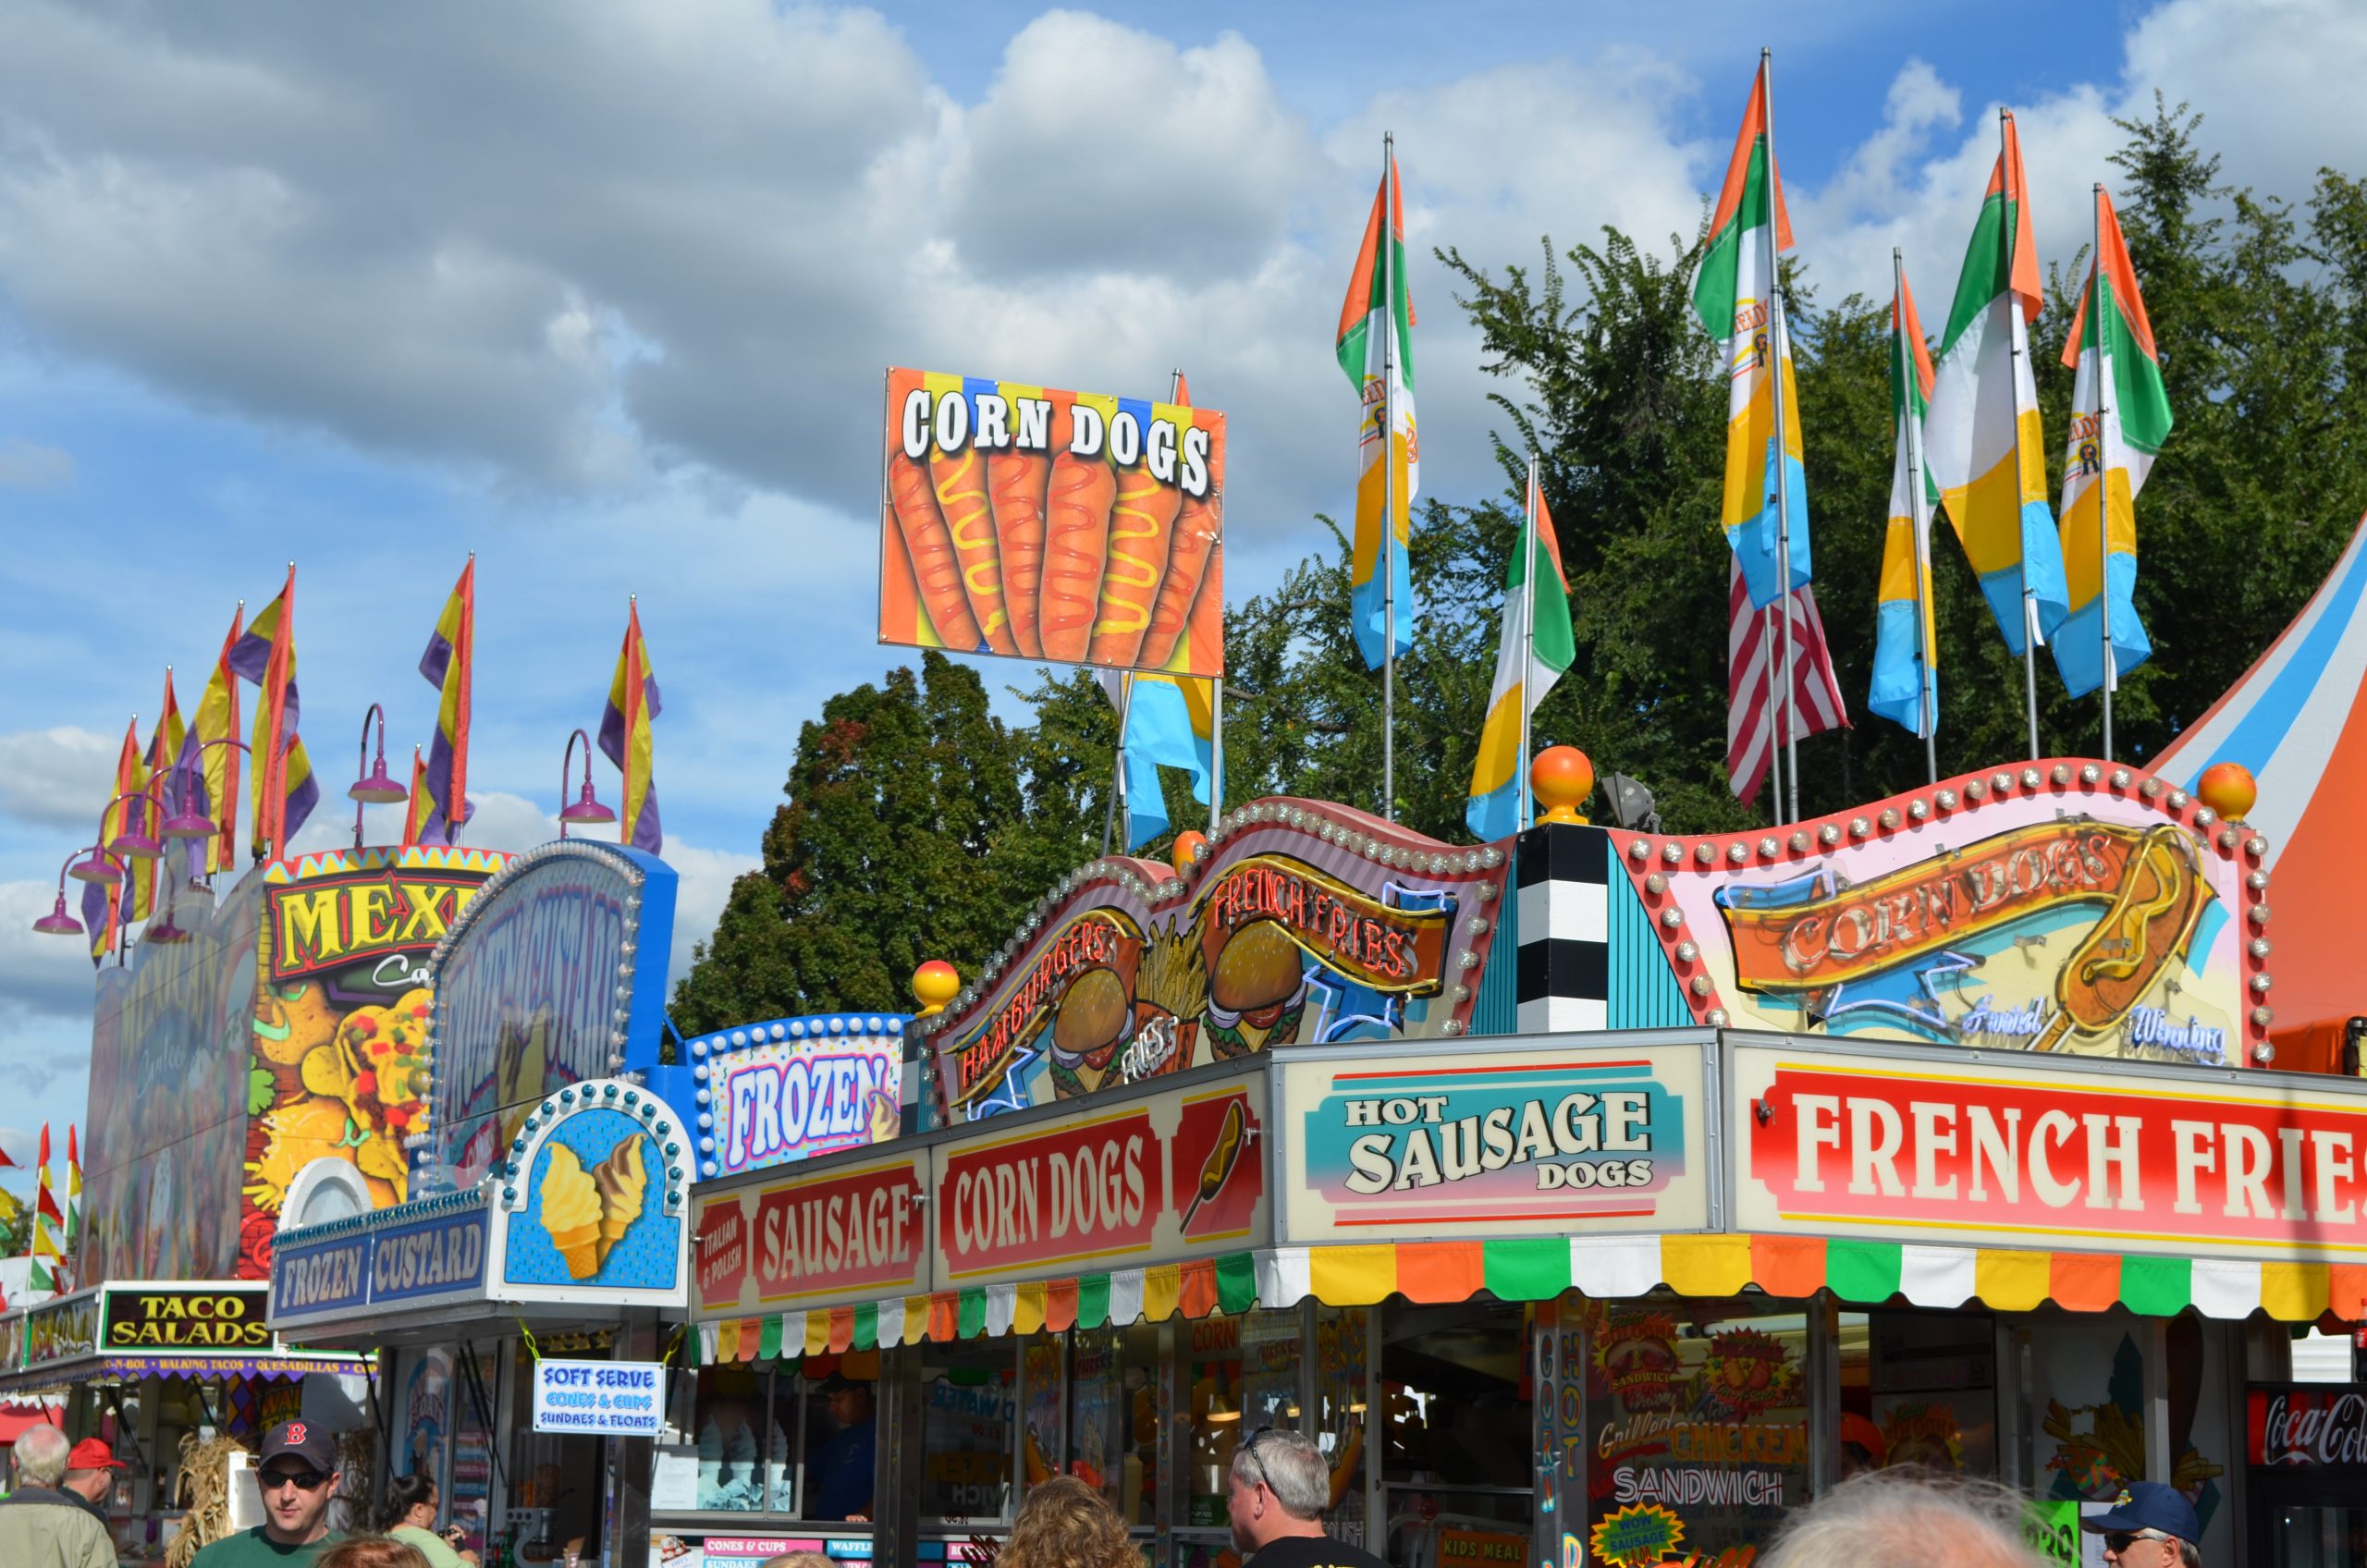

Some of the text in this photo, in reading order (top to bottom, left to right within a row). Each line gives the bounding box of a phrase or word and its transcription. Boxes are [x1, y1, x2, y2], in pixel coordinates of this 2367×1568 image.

[901, 388, 1208, 496] CORN DOGS
[1214, 868, 1407, 977] FRENCH FRIES
[1785, 834, 2116, 971] CORN DOGS
[963, 921, 1108, 1088] HAMBURGERS
[727, 1055, 888, 1169] FROZEN
[1344, 1095, 1448, 1127] HOT
[1343, 1091, 1651, 1194] SAUSAGE
[1792, 1093, 2367, 1224] FRENCH FRIE
[953, 1134, 1146, 1255] CORN DOGS
[1536, 1159, 1652, 1191] DOGS
[704, 1216, 738, 1258] ITALIAN
[762, 1183, 910, 1281] SAUSAGE
[280, 1223, 482, 1309] FROZEN CUSTARD
[703, 1243, 742, 1290] & POLISH
[140, 1296, 245, 1319] TACO
[112, 1321, 269, 1344] SALADS
[1193, 1320, 1237, 1353] CORN
[159, 1358, 207, 1370] WALKING
[211, 1359, 244, 1371] TACOS
[256, 1360, 340, 1374] QUESADILLAS
[544, 1367, 655, 1390] SOFT SERVE
[541, 1411, 657, 1428] SUNDAES & FLOATS
[546, 1391, 653, 1411] CONES & CUPS
[1561, 1332, 1581, 1480] HOT
[285, 1422, 308, 1445] B
[1539, 1334, 1557, 1513] CORN
[1598, 1406, 1676, 1460] Grilled
[1671, 1421, 1809, 1465] CHICKEN
[1613, 1466, 1783, 1506] SANDWICH
[1609, 1531, 1665, 1552] SAUSAGE
[1618, 1515, 1652, 1530] WOW
[707, 1541, 786, 1552] CONES & CUPS
[832, 1541, 874, 1551] WAFFLE
[1443, 1539, 1521, 1561] KIDS MEAL
